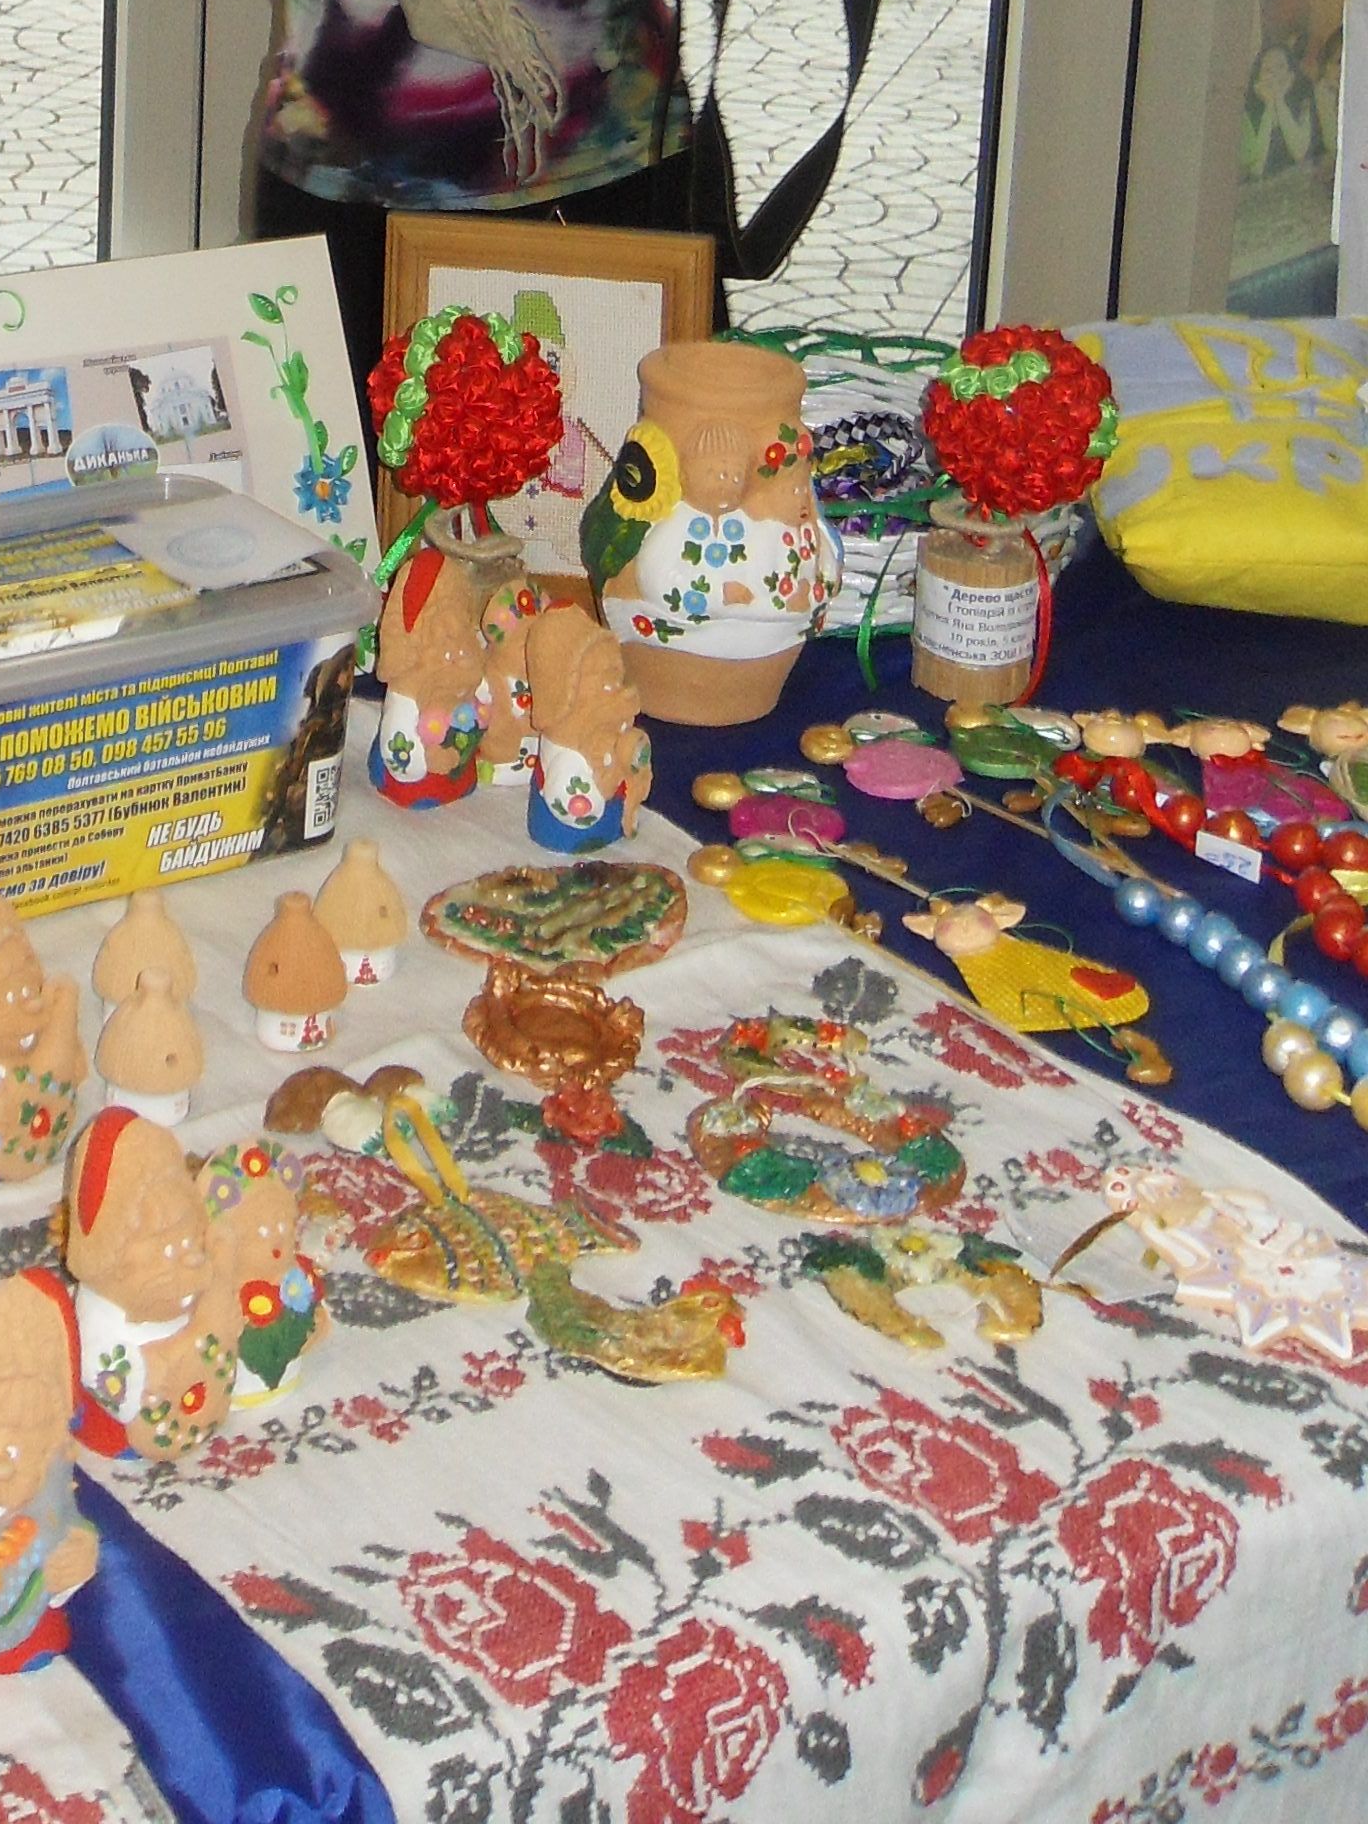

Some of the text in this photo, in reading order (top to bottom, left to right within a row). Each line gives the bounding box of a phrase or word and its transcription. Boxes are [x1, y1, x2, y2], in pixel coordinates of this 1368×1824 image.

[73, 448, 149, 472] ДИКАНЬКА
[951, 588, 1001, 604] Дерево
[29, 693, 78, 719] жителі
[80, 686, 119, 706] міста
[122, 682, 136, 697] та
[138, 663, 217, 693] підприємці
[219, 648, 279, 676] Полтави!
[134, 675, 277, 731] ВІЙСЬКОВИМ
[5, 760, 38, 786] 769
[41, 753, 66, 778] 08
[101, 737, 138, 764] 098
[141, 730, 173, 754] 457
[175, 723, 199, 747] 55
[202, 717, 227, 741] 96
[67, 761, 142, 790] Полтавський
[143, 749, 202, 772] батальйон
[0, 827, 31, 848] 7420
[33, 817, 70, 839] 6385
[73, 809, 106, 829] 5377
[108, 796, 170, 822] (Бубнюк
[172, 777, 247, 807] Валентин)
[38, 790, 118, 819] перерахувати
[120, 787, 134, 800] на
[136, 778, 175, 797] картку
[176, 761, 249, 787] ПриватБанку
[146, 810, 224, 848] НЕ БУДЬ
[159, 827, 266, 873] БАЙДУЖИМ
